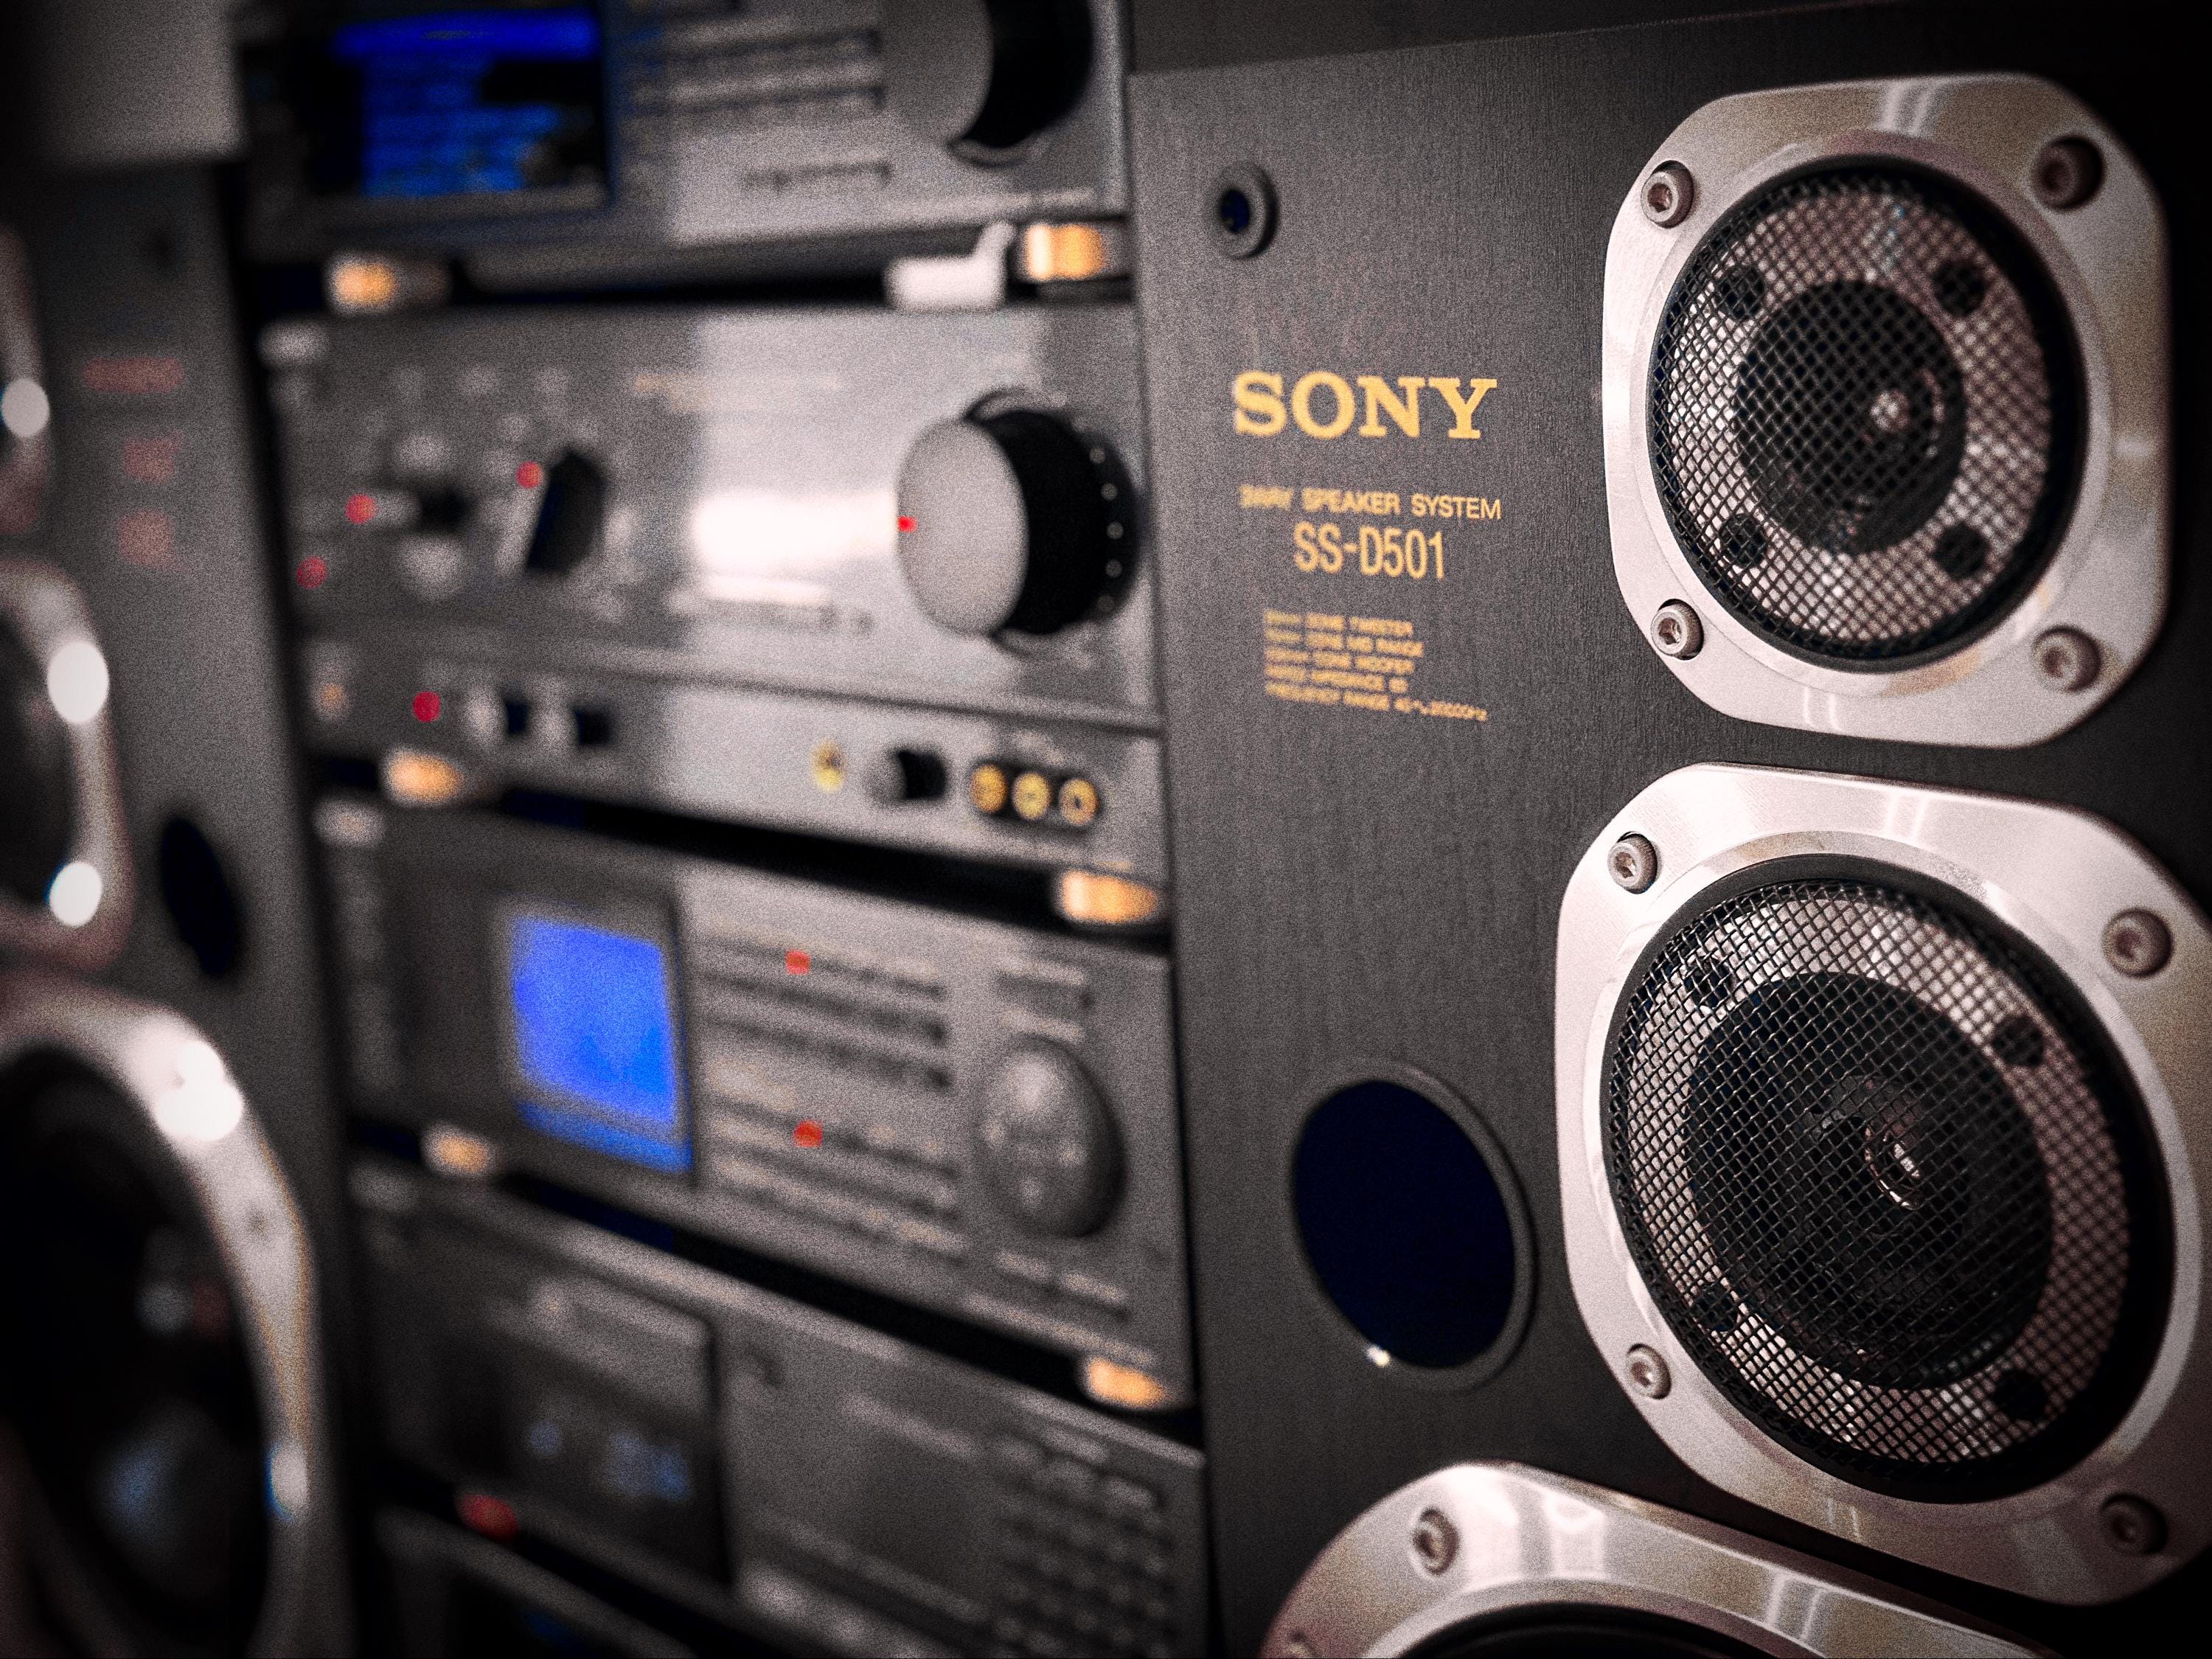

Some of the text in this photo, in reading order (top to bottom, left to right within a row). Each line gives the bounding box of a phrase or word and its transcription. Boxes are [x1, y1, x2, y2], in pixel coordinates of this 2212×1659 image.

[1234, 371, 1497, 439] SONY
[1302, 488, 1400, 515] SPEAKER
[1411, 493, 1501, 520] SYSTEM
[1294, 521, 1444, 579] SS-D501
